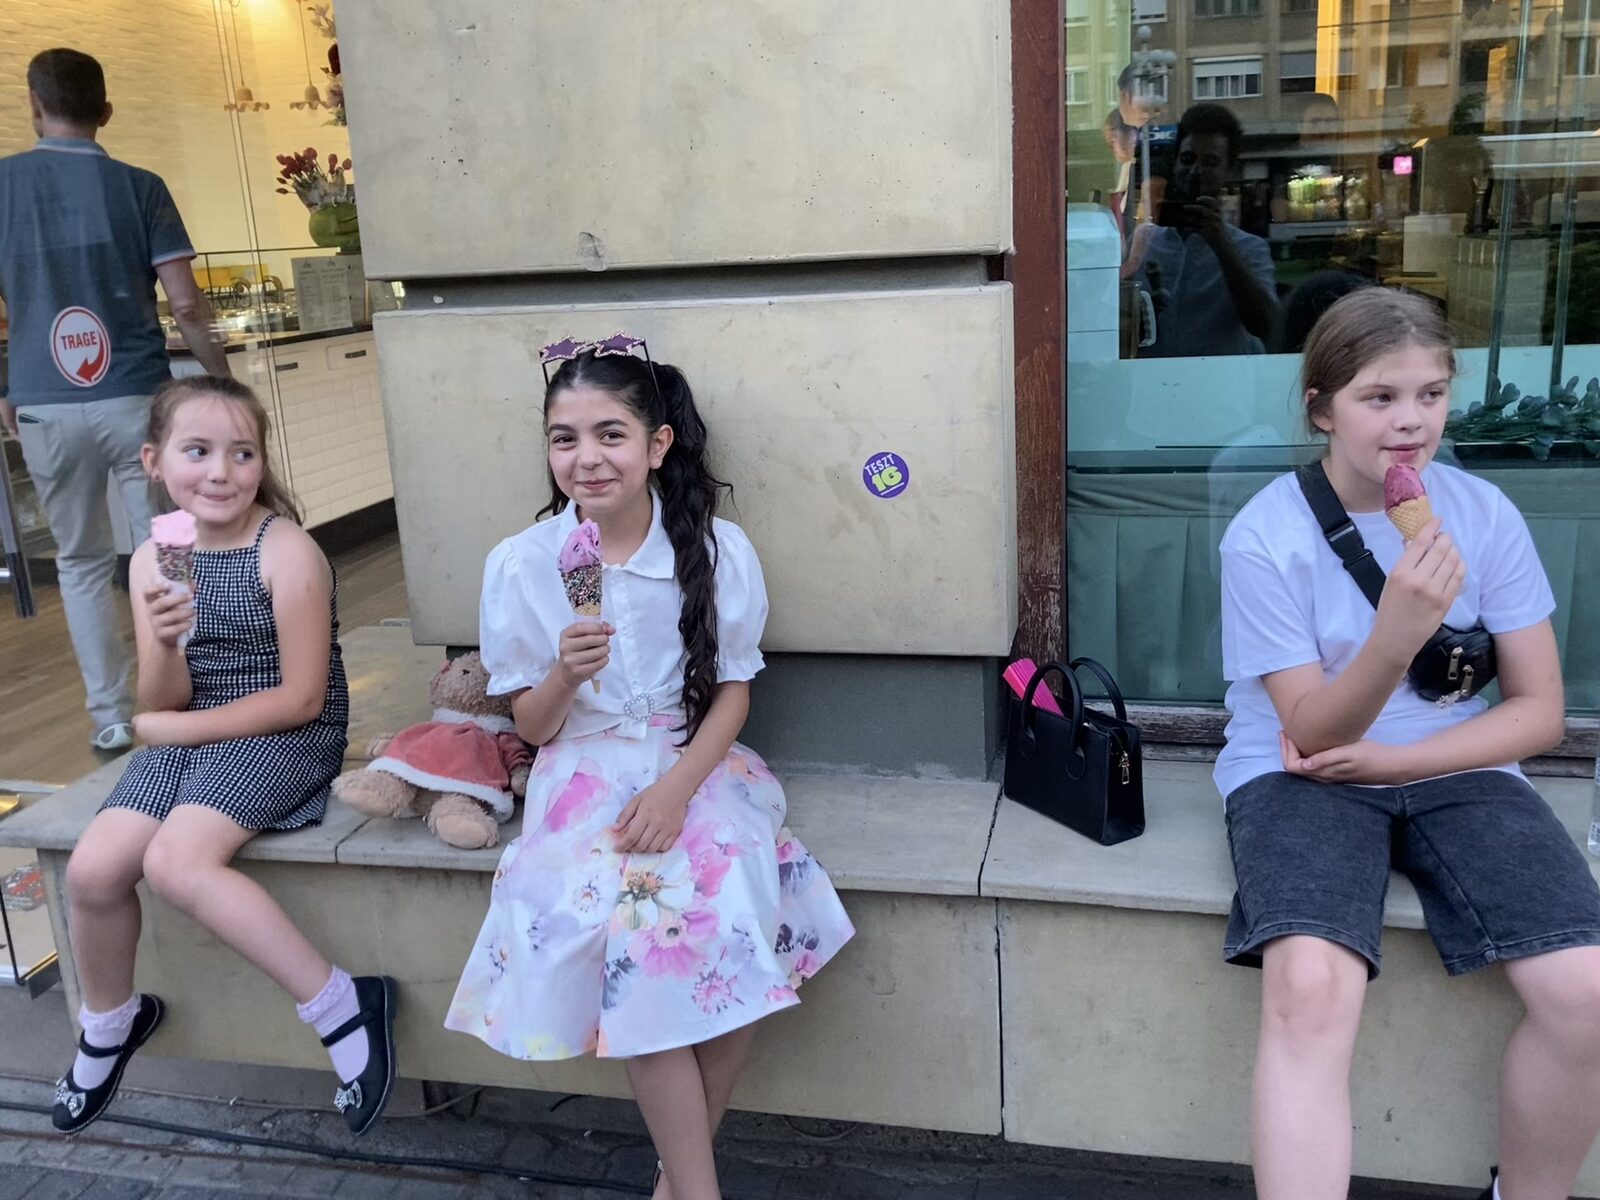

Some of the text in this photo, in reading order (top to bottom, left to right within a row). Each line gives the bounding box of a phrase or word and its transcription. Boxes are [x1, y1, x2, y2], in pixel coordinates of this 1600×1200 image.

[61, 331, 97, 350] TRAGE
[864, 453, 895, 476] TESZT
[872, 466, 902, 492] 16
